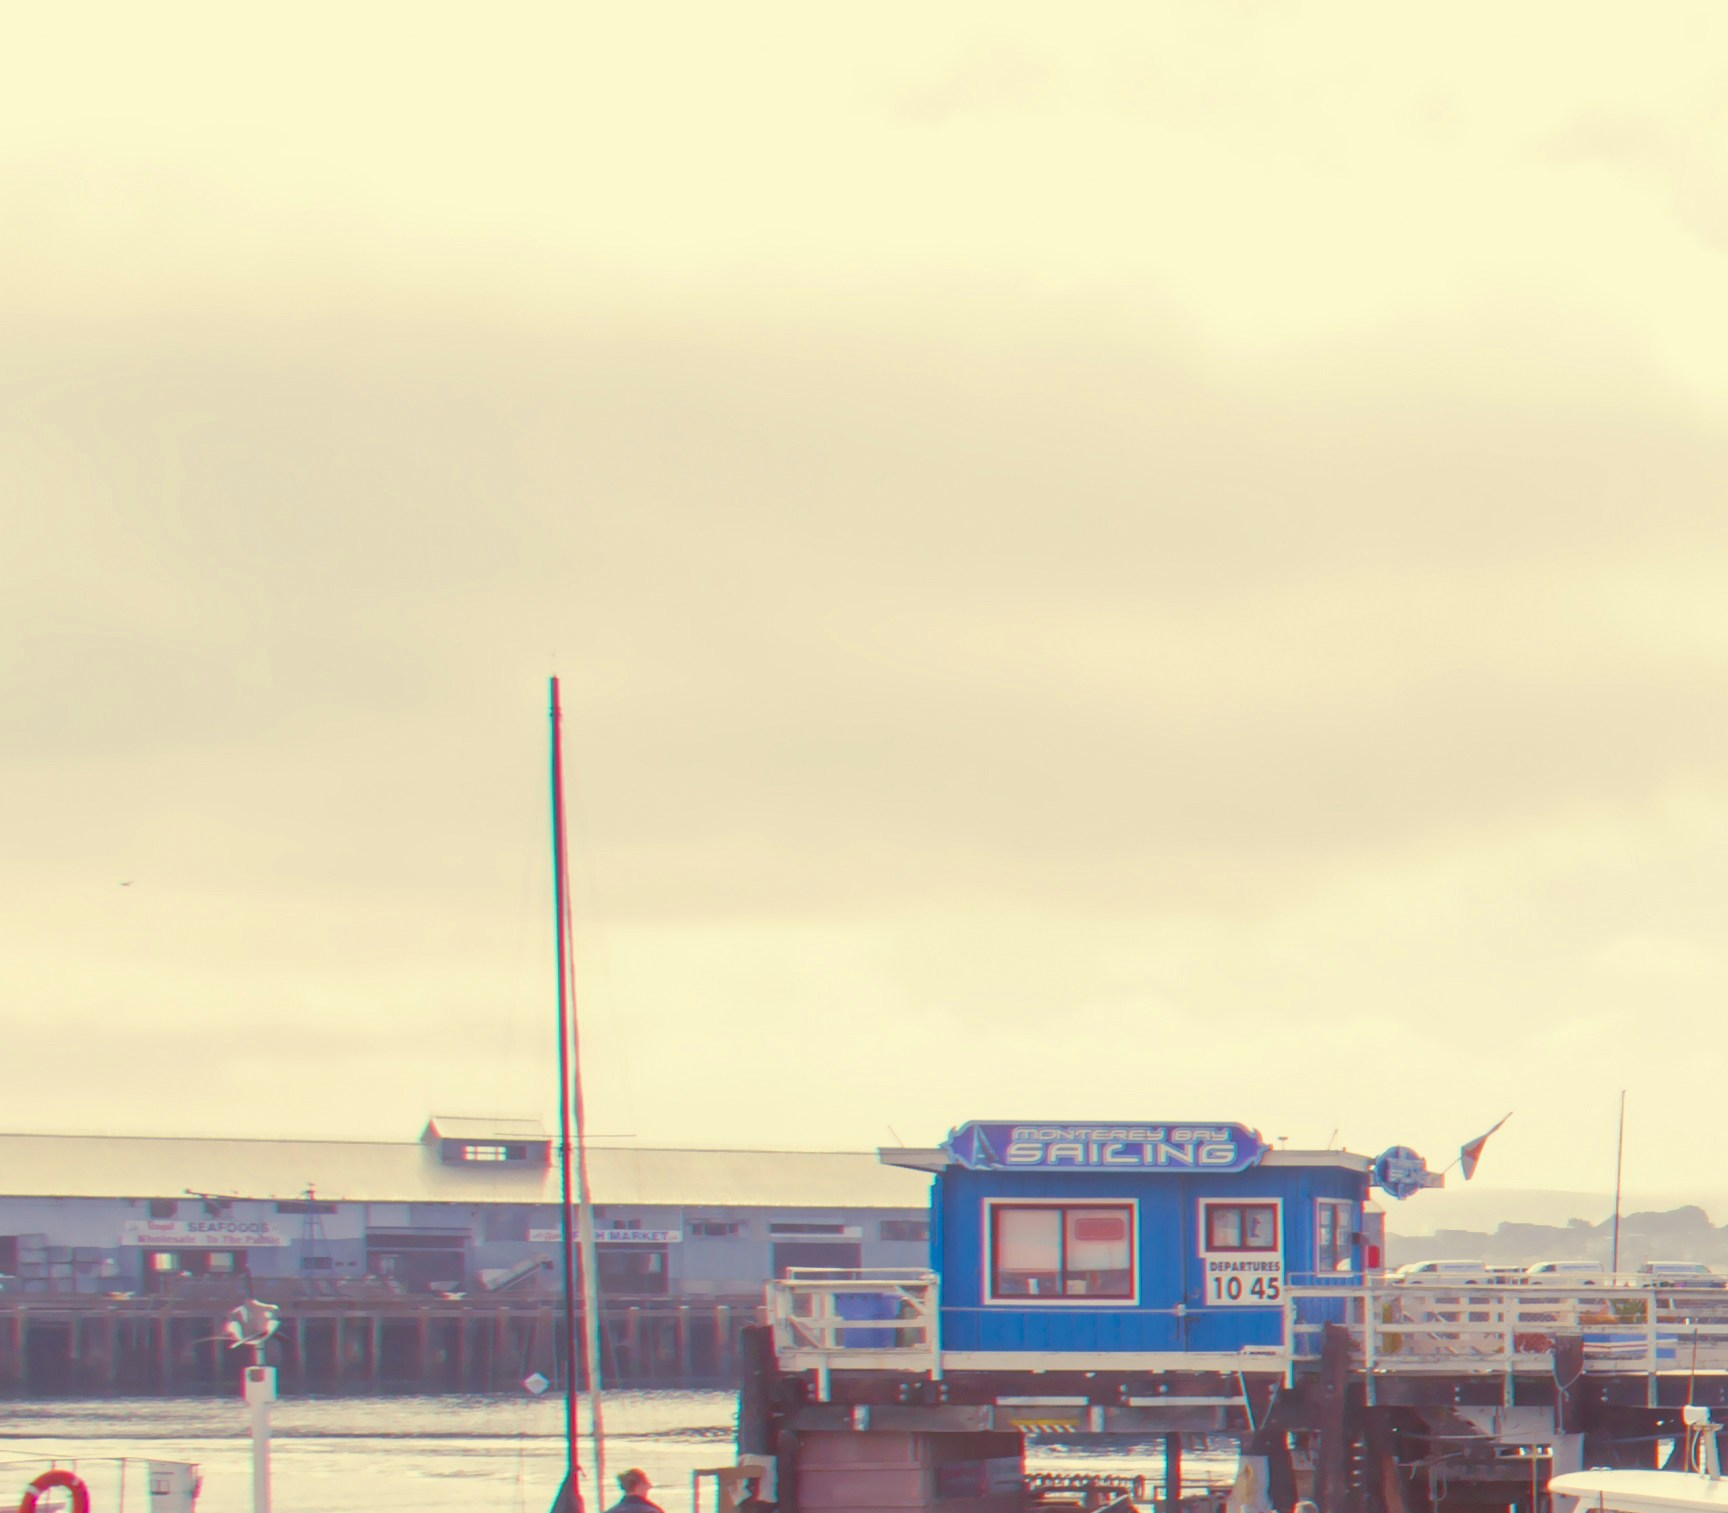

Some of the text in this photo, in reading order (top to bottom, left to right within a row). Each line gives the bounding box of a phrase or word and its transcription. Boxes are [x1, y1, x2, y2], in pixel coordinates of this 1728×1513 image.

[1012, 1127, 1232, 1142] MONTEREY BAY
[1007, 1142, 1237, 1167] SAILING
[188, 1222, 270, 1232] SEAFOODS
[609, 1231, 668, 1240] MARKET
[1210, 1261, 1280, 1271] DEPARTURES
[1214, 1276, 1281, 1301] 10 45
